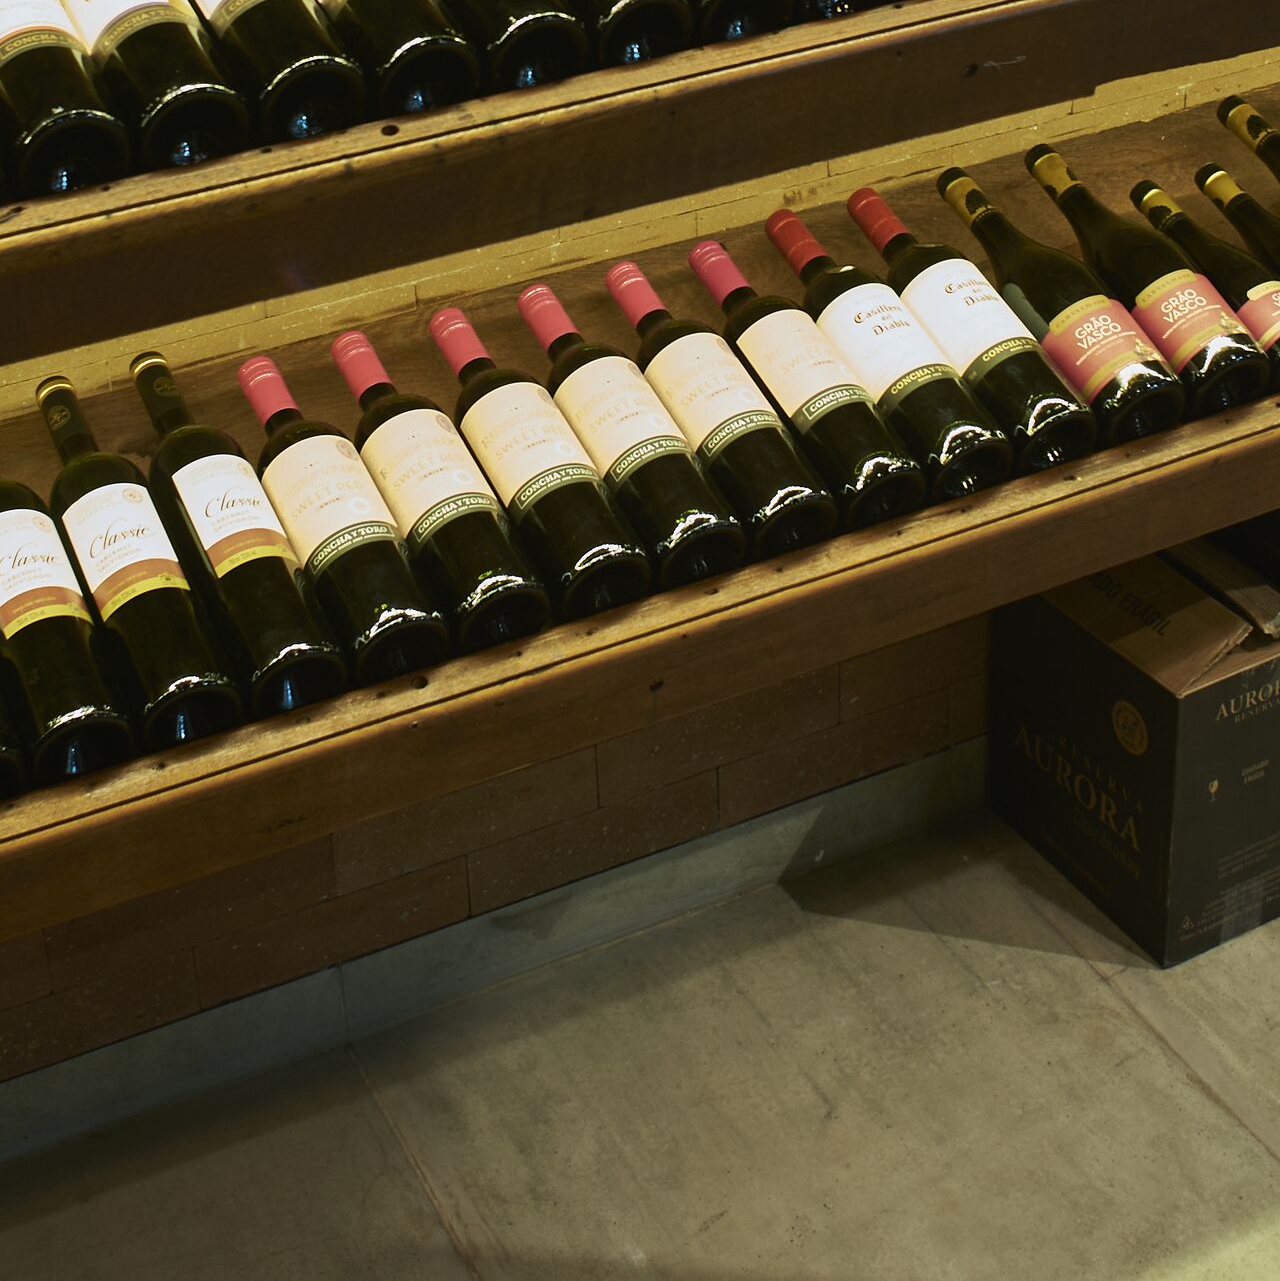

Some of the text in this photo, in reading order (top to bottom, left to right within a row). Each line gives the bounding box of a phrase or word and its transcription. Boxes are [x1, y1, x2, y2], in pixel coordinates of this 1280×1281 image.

[1160, 288, 1197, 314] GRÃO
[1163, 297, 1207, 325] VASCO
[1074, 314, 1111, 340] GRÃO
[1077, 323, 1122, 351] VASCO
[204, 485, 266, 519] Classic
[89, 518, 157, 560] Classic
[1012, 721, 1143, 854] AURORA
